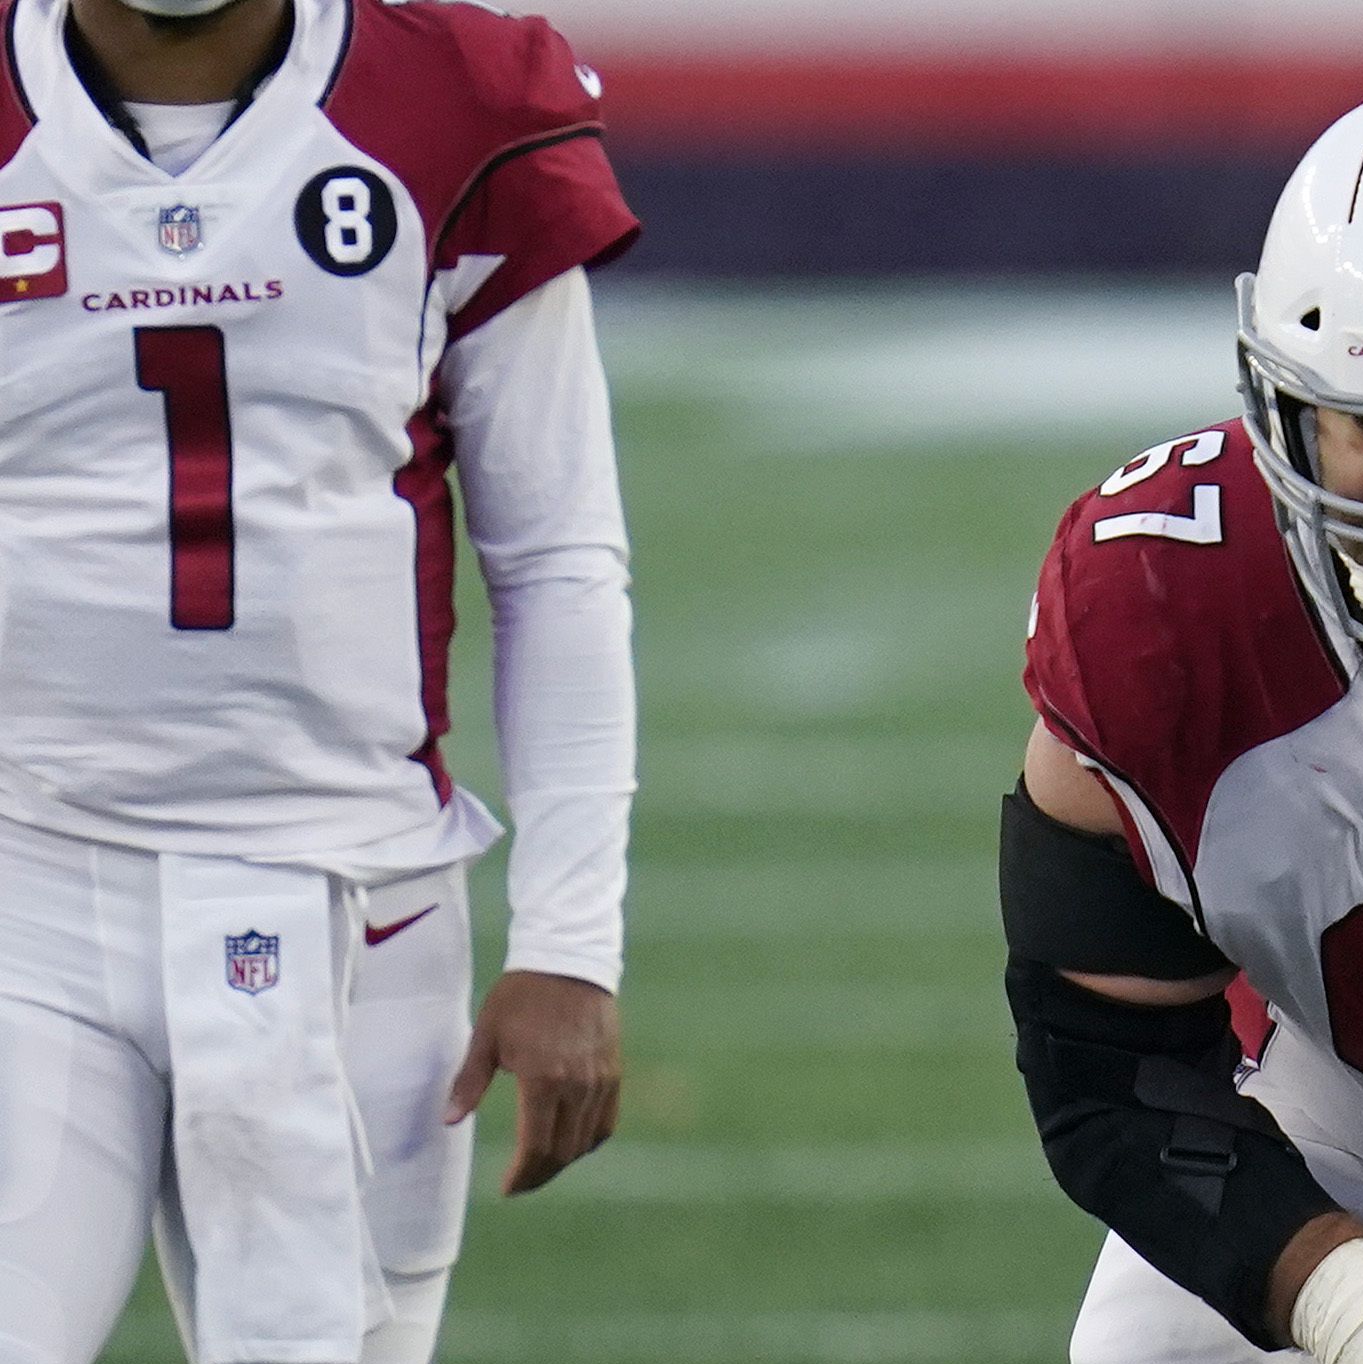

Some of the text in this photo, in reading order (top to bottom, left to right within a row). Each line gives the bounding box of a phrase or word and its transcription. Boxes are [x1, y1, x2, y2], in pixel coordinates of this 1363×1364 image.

[321, 176, 373, 264] 8
[81, 280, 284, 312] CARDINALS
[133, 324, 235, 630] 1
[231, 957, 274, 989] NFL
